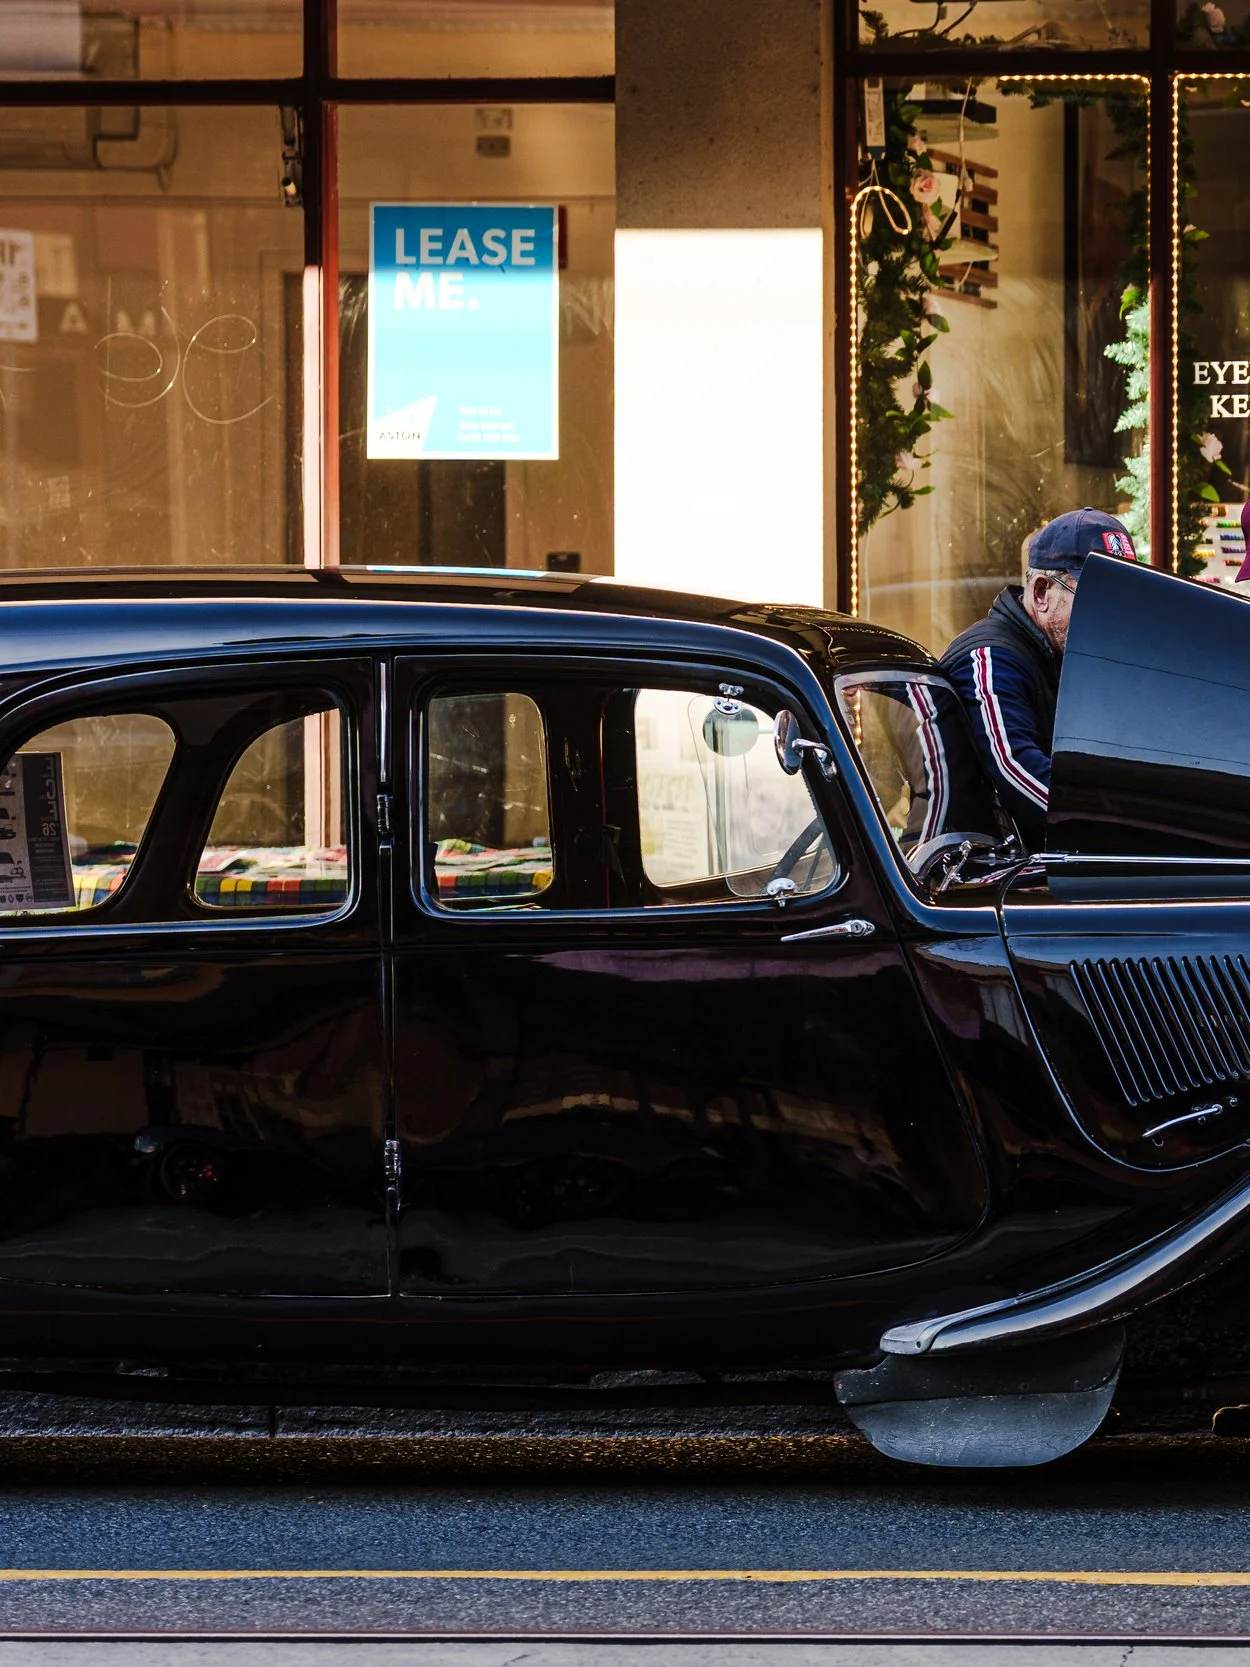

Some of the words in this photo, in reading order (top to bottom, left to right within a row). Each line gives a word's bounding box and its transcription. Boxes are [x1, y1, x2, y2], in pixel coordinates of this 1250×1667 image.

[395, 228, 536, 266] LEASE
[393, 271, 480, 311] ME.
[379, 430, 421, 441] ASTON
